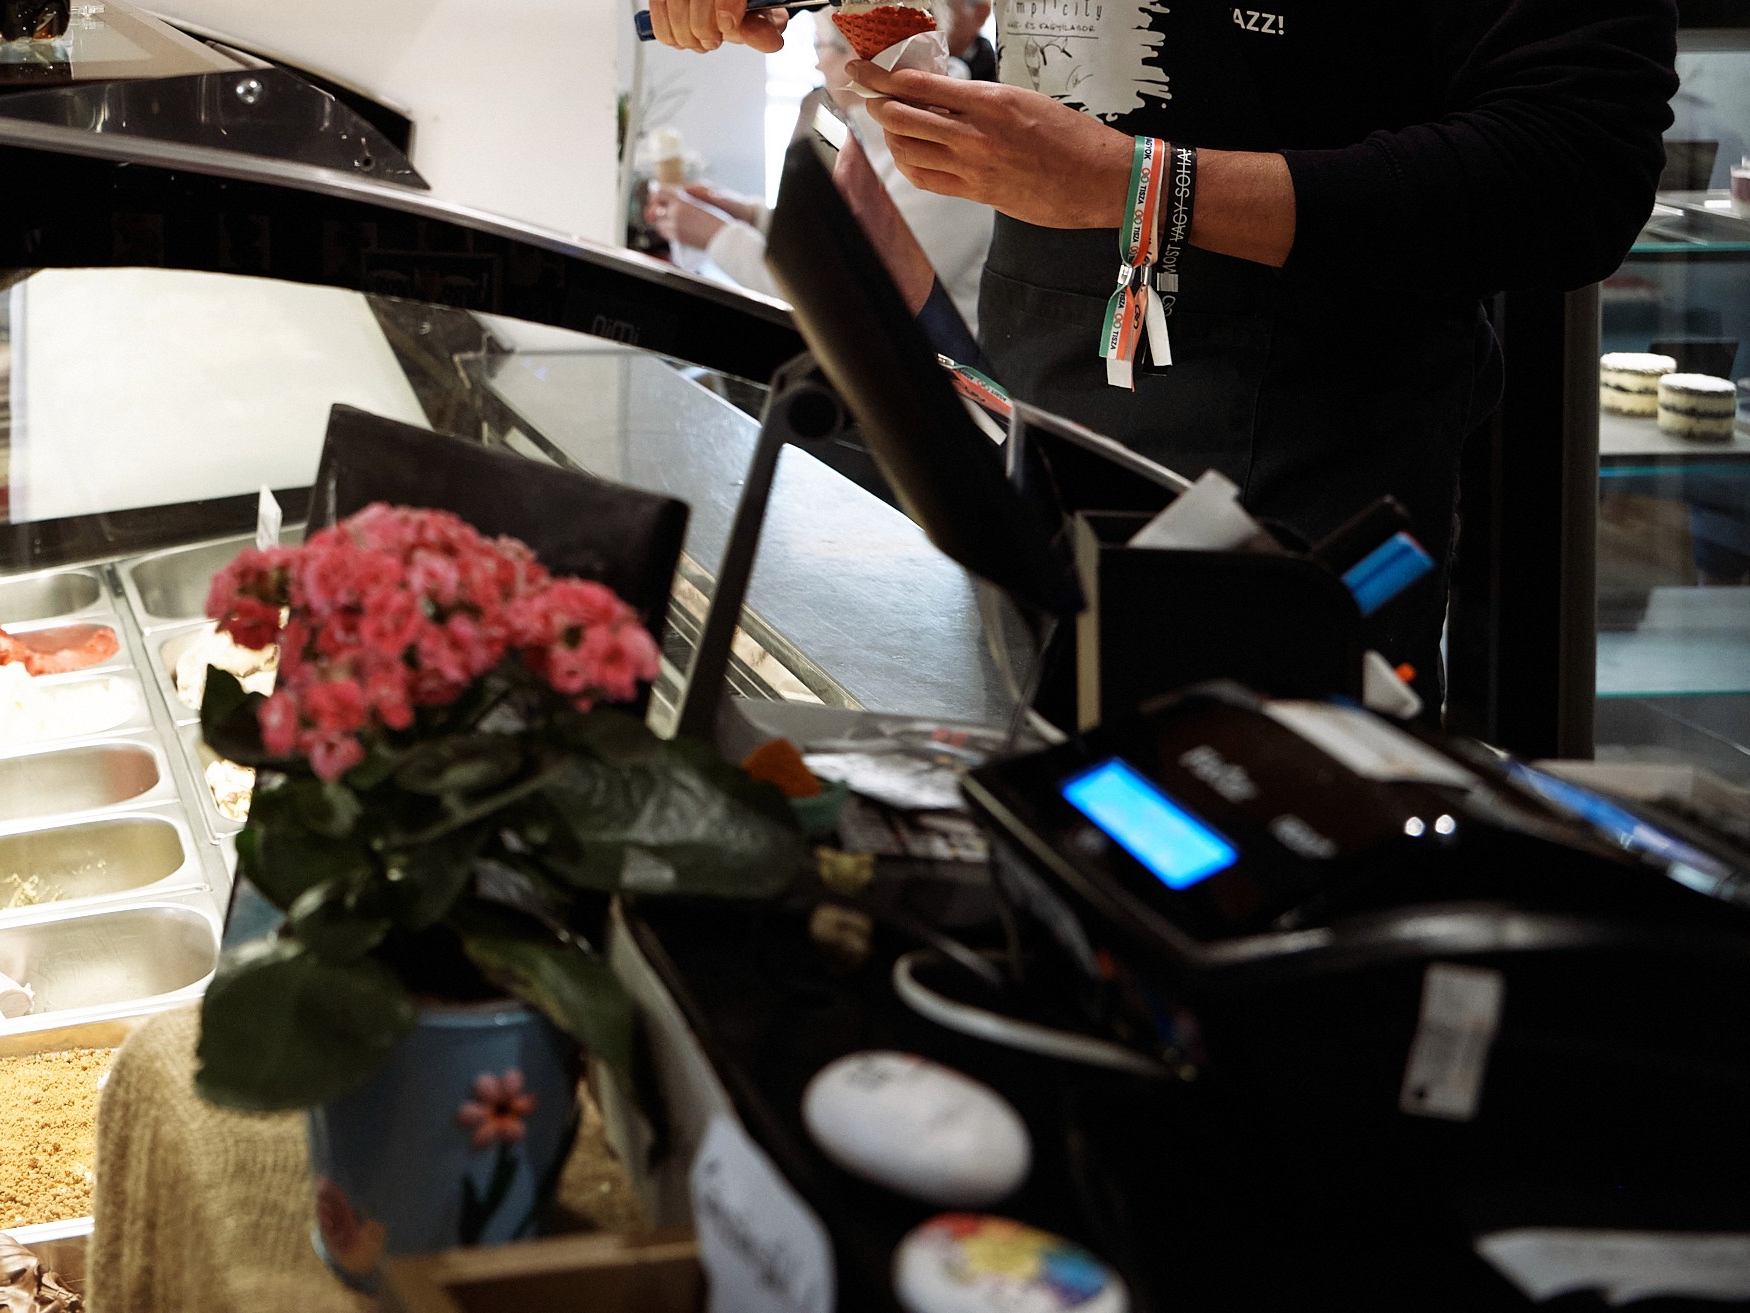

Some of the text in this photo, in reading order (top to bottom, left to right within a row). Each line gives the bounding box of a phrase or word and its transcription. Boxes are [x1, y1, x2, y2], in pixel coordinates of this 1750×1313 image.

[1230, 7, 1285, 36] AZZ!
[1175, 148, 1192, 198] SOHA!
[1137, 185, 1147, 205] TISZA
[1169, 201, 1188, 242] VAGY
[1132, 226, 1141, 243] TISZA
[1110, 331, 1119, 350] TISZA
